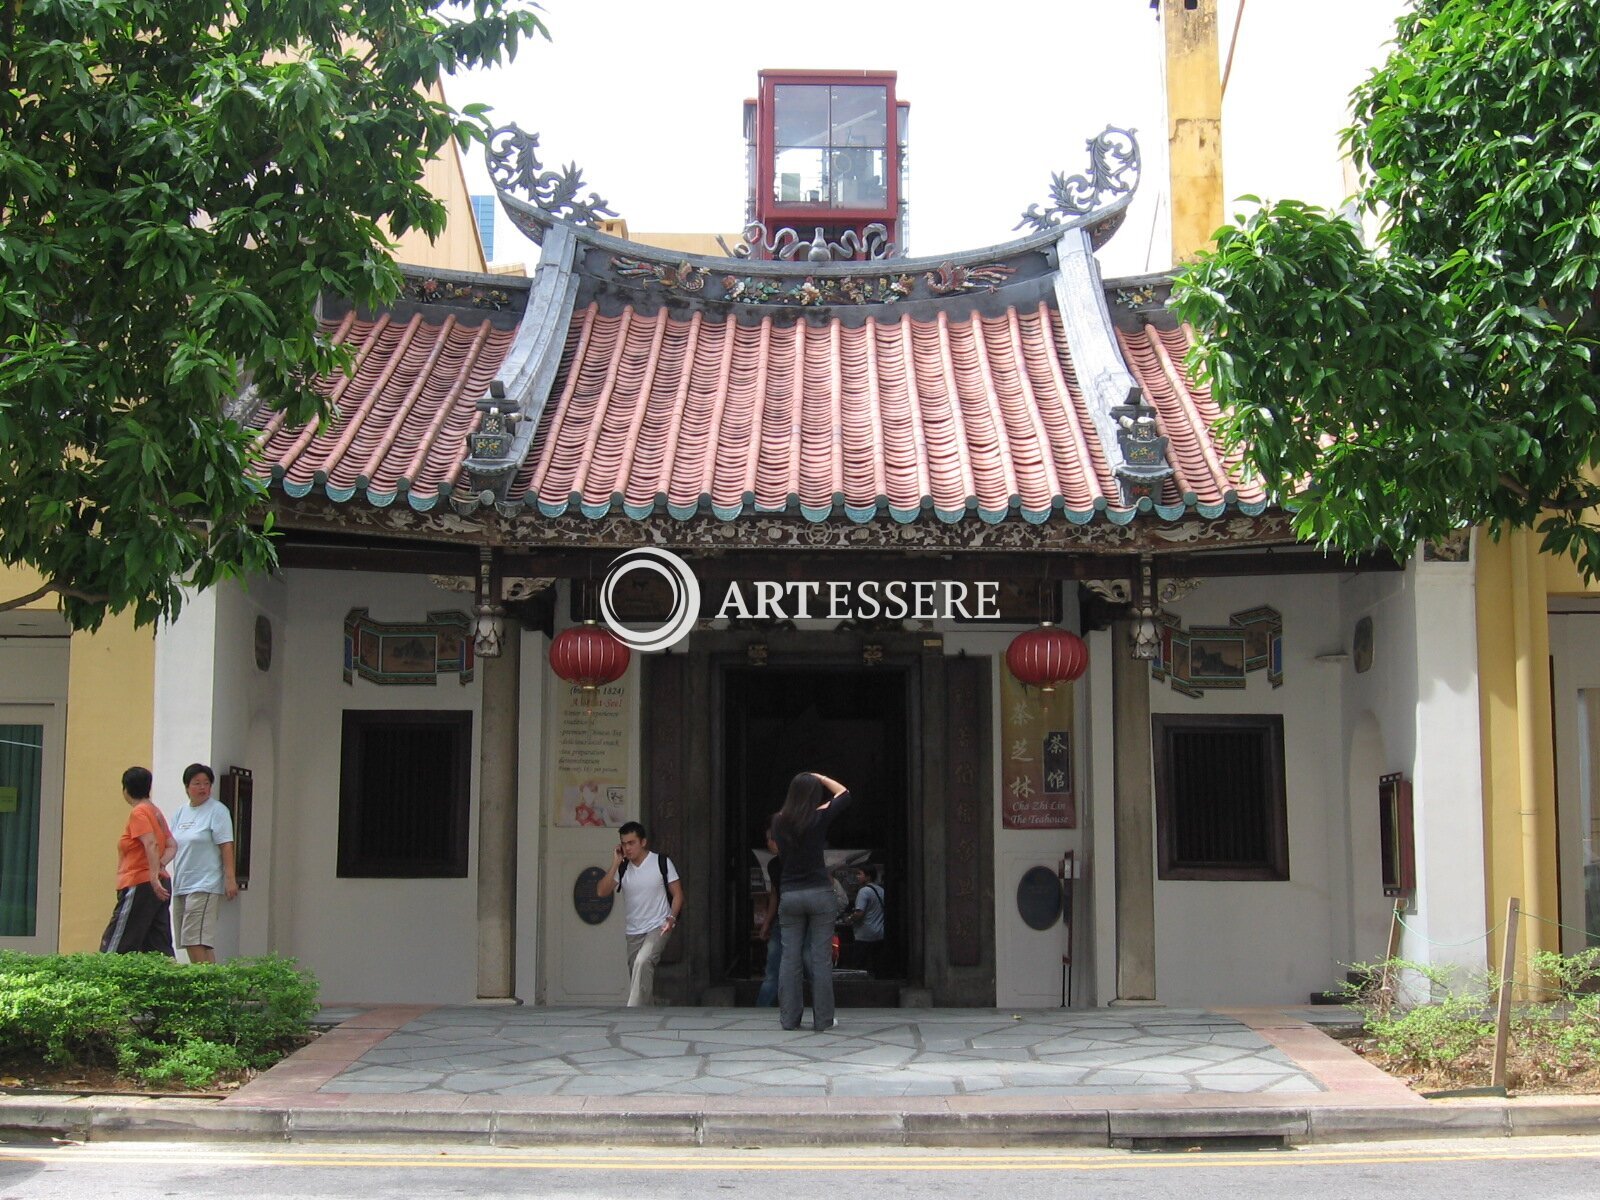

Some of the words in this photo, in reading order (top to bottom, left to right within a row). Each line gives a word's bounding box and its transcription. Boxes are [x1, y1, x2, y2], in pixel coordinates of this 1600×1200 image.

[602, 687, 624, 696] 1824)
[1047, 734, 1067, 790] 茶馆
[1010, 814, 1026, 824] The
[1028, 813, 1069, 824] Teahouse
